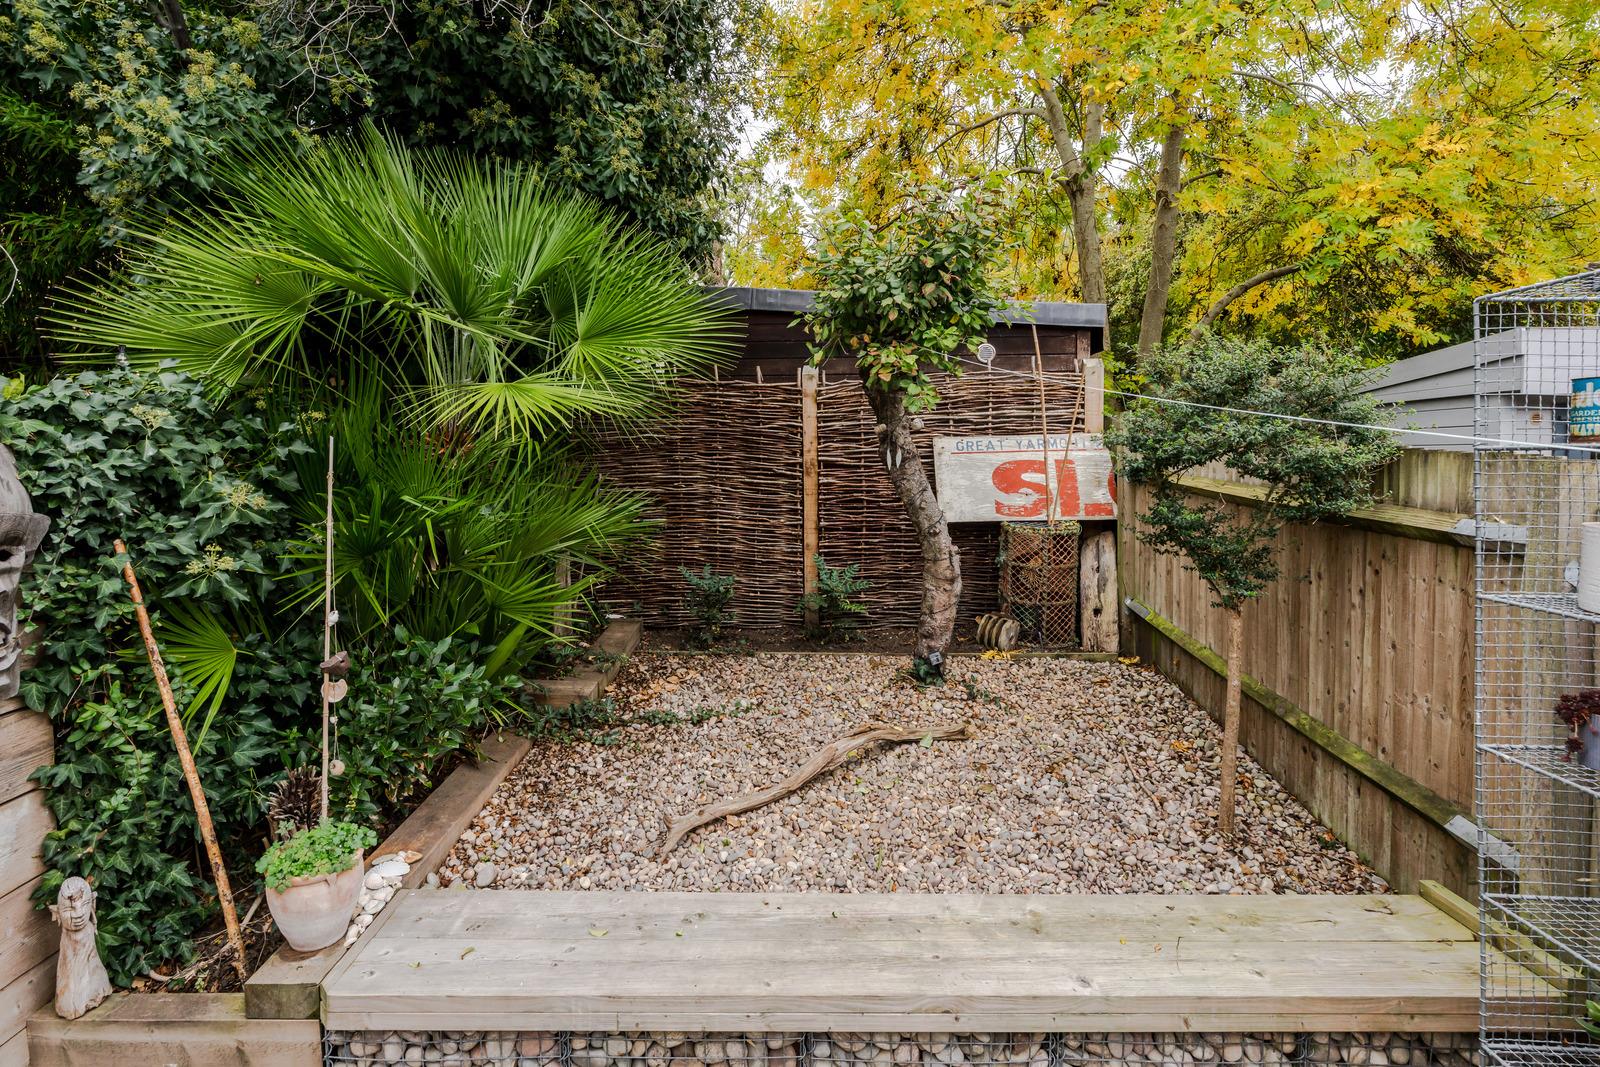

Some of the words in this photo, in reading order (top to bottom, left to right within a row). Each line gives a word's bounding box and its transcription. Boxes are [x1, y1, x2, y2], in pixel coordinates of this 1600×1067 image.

[956, 439, 1005, 451] GREAT
[1016, 437, 1101, 450] YARMOT
[992, 459, 1118, 517] SL
